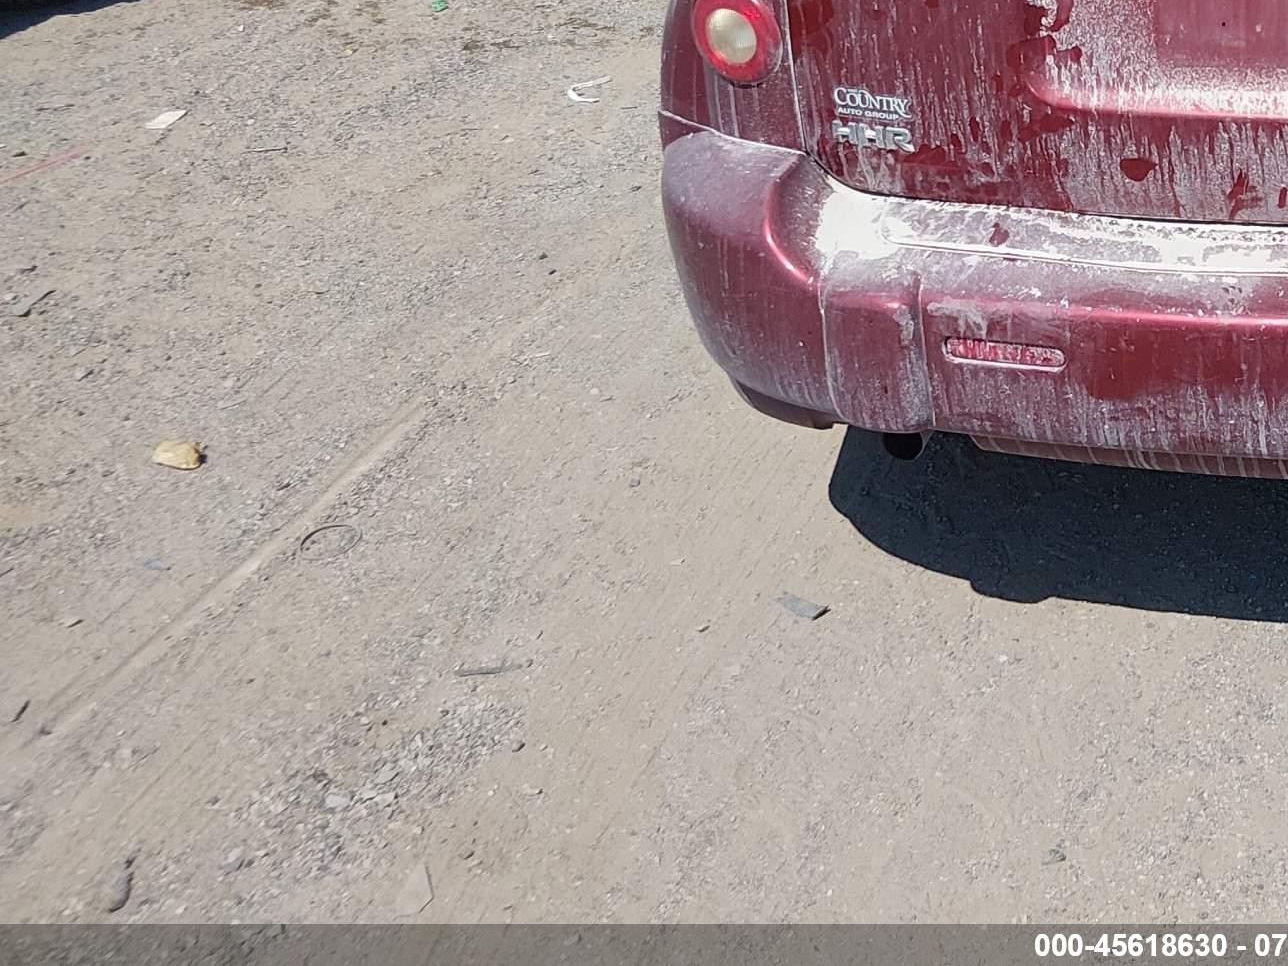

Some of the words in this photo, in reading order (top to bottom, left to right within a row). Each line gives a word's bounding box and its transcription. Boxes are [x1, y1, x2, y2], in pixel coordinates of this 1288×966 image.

[834, 87, 912, 118] COUNTRY
[837, 107, 863, 116] AUTO
[864, 111, 900, 120] GROUP
[832, 120, 915, 153] HHR
